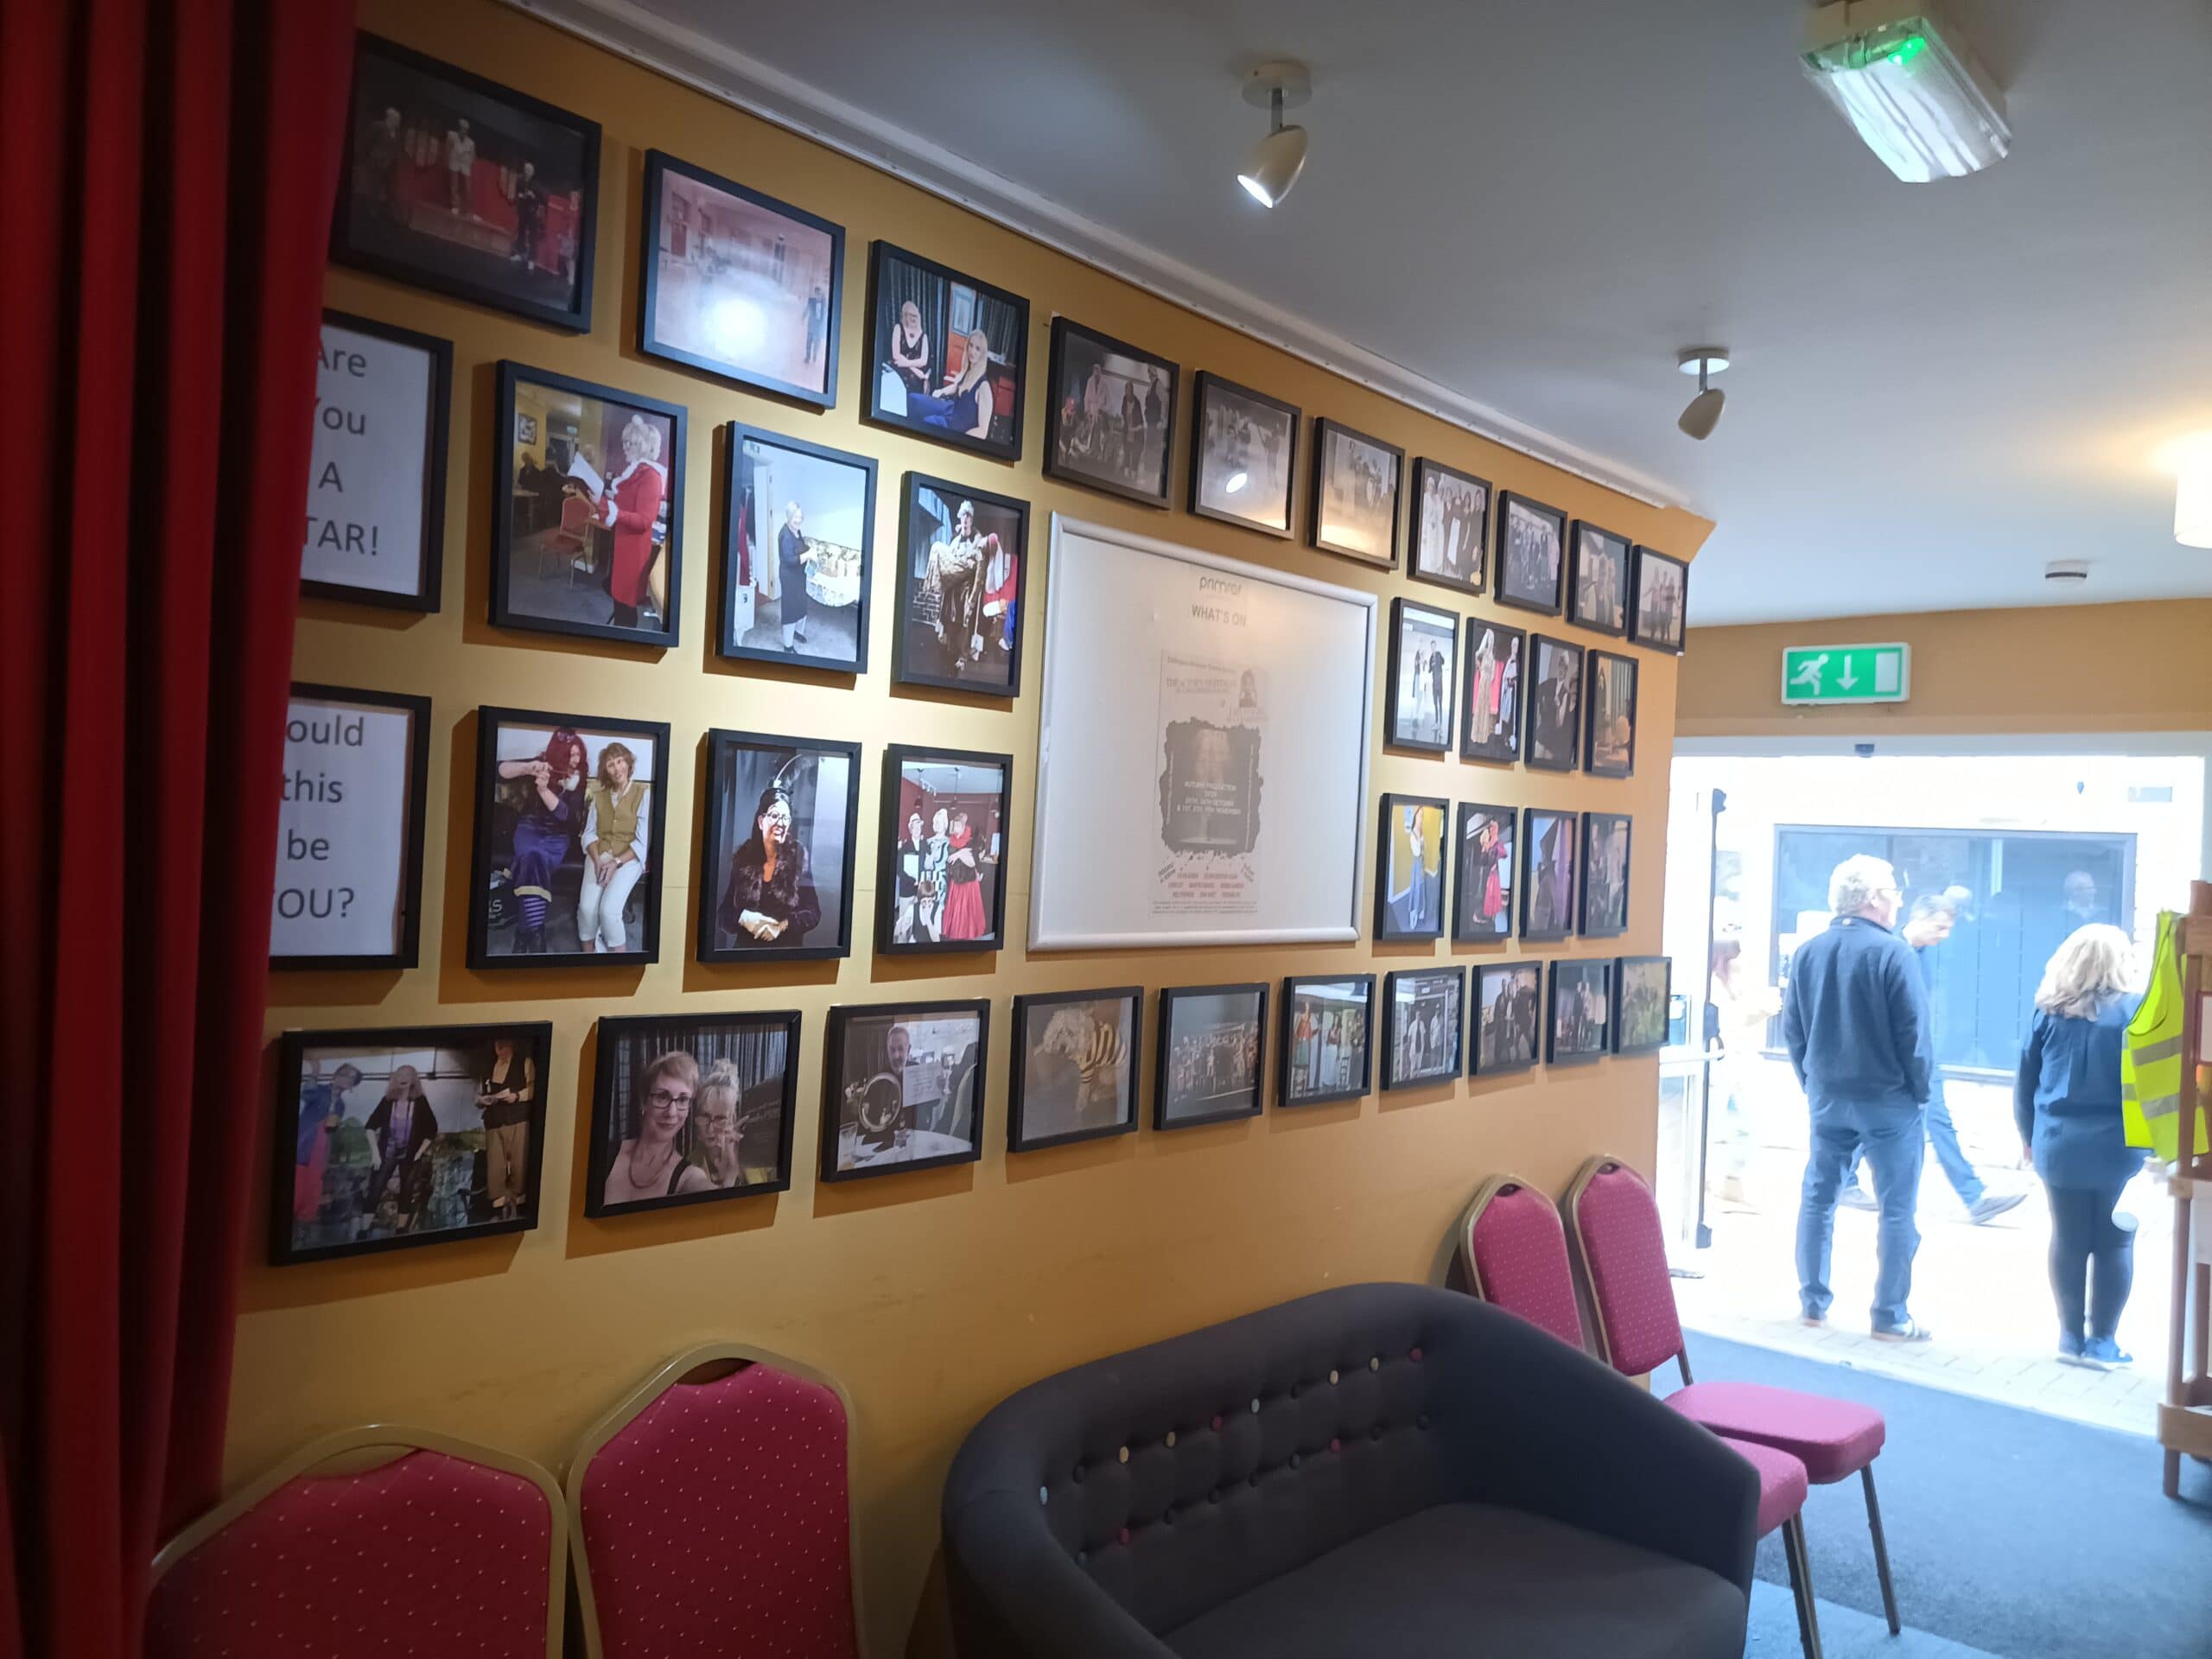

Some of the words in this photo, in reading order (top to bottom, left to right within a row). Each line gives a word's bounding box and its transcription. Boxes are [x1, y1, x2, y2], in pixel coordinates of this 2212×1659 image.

[316, 397, 365, 435] ou
[316, 461, 344, 493] A
[305, 517, 378, 556] TAR!
[1192, 604, 1230, 624] WHAT'S
[1232, 613, 1247, 627] ON
[286, 714, 364, 747] ould
[282, 770, 342, 803] this
[288, 829, 329, 861] be
[277, 887, 354, 918] OU?
